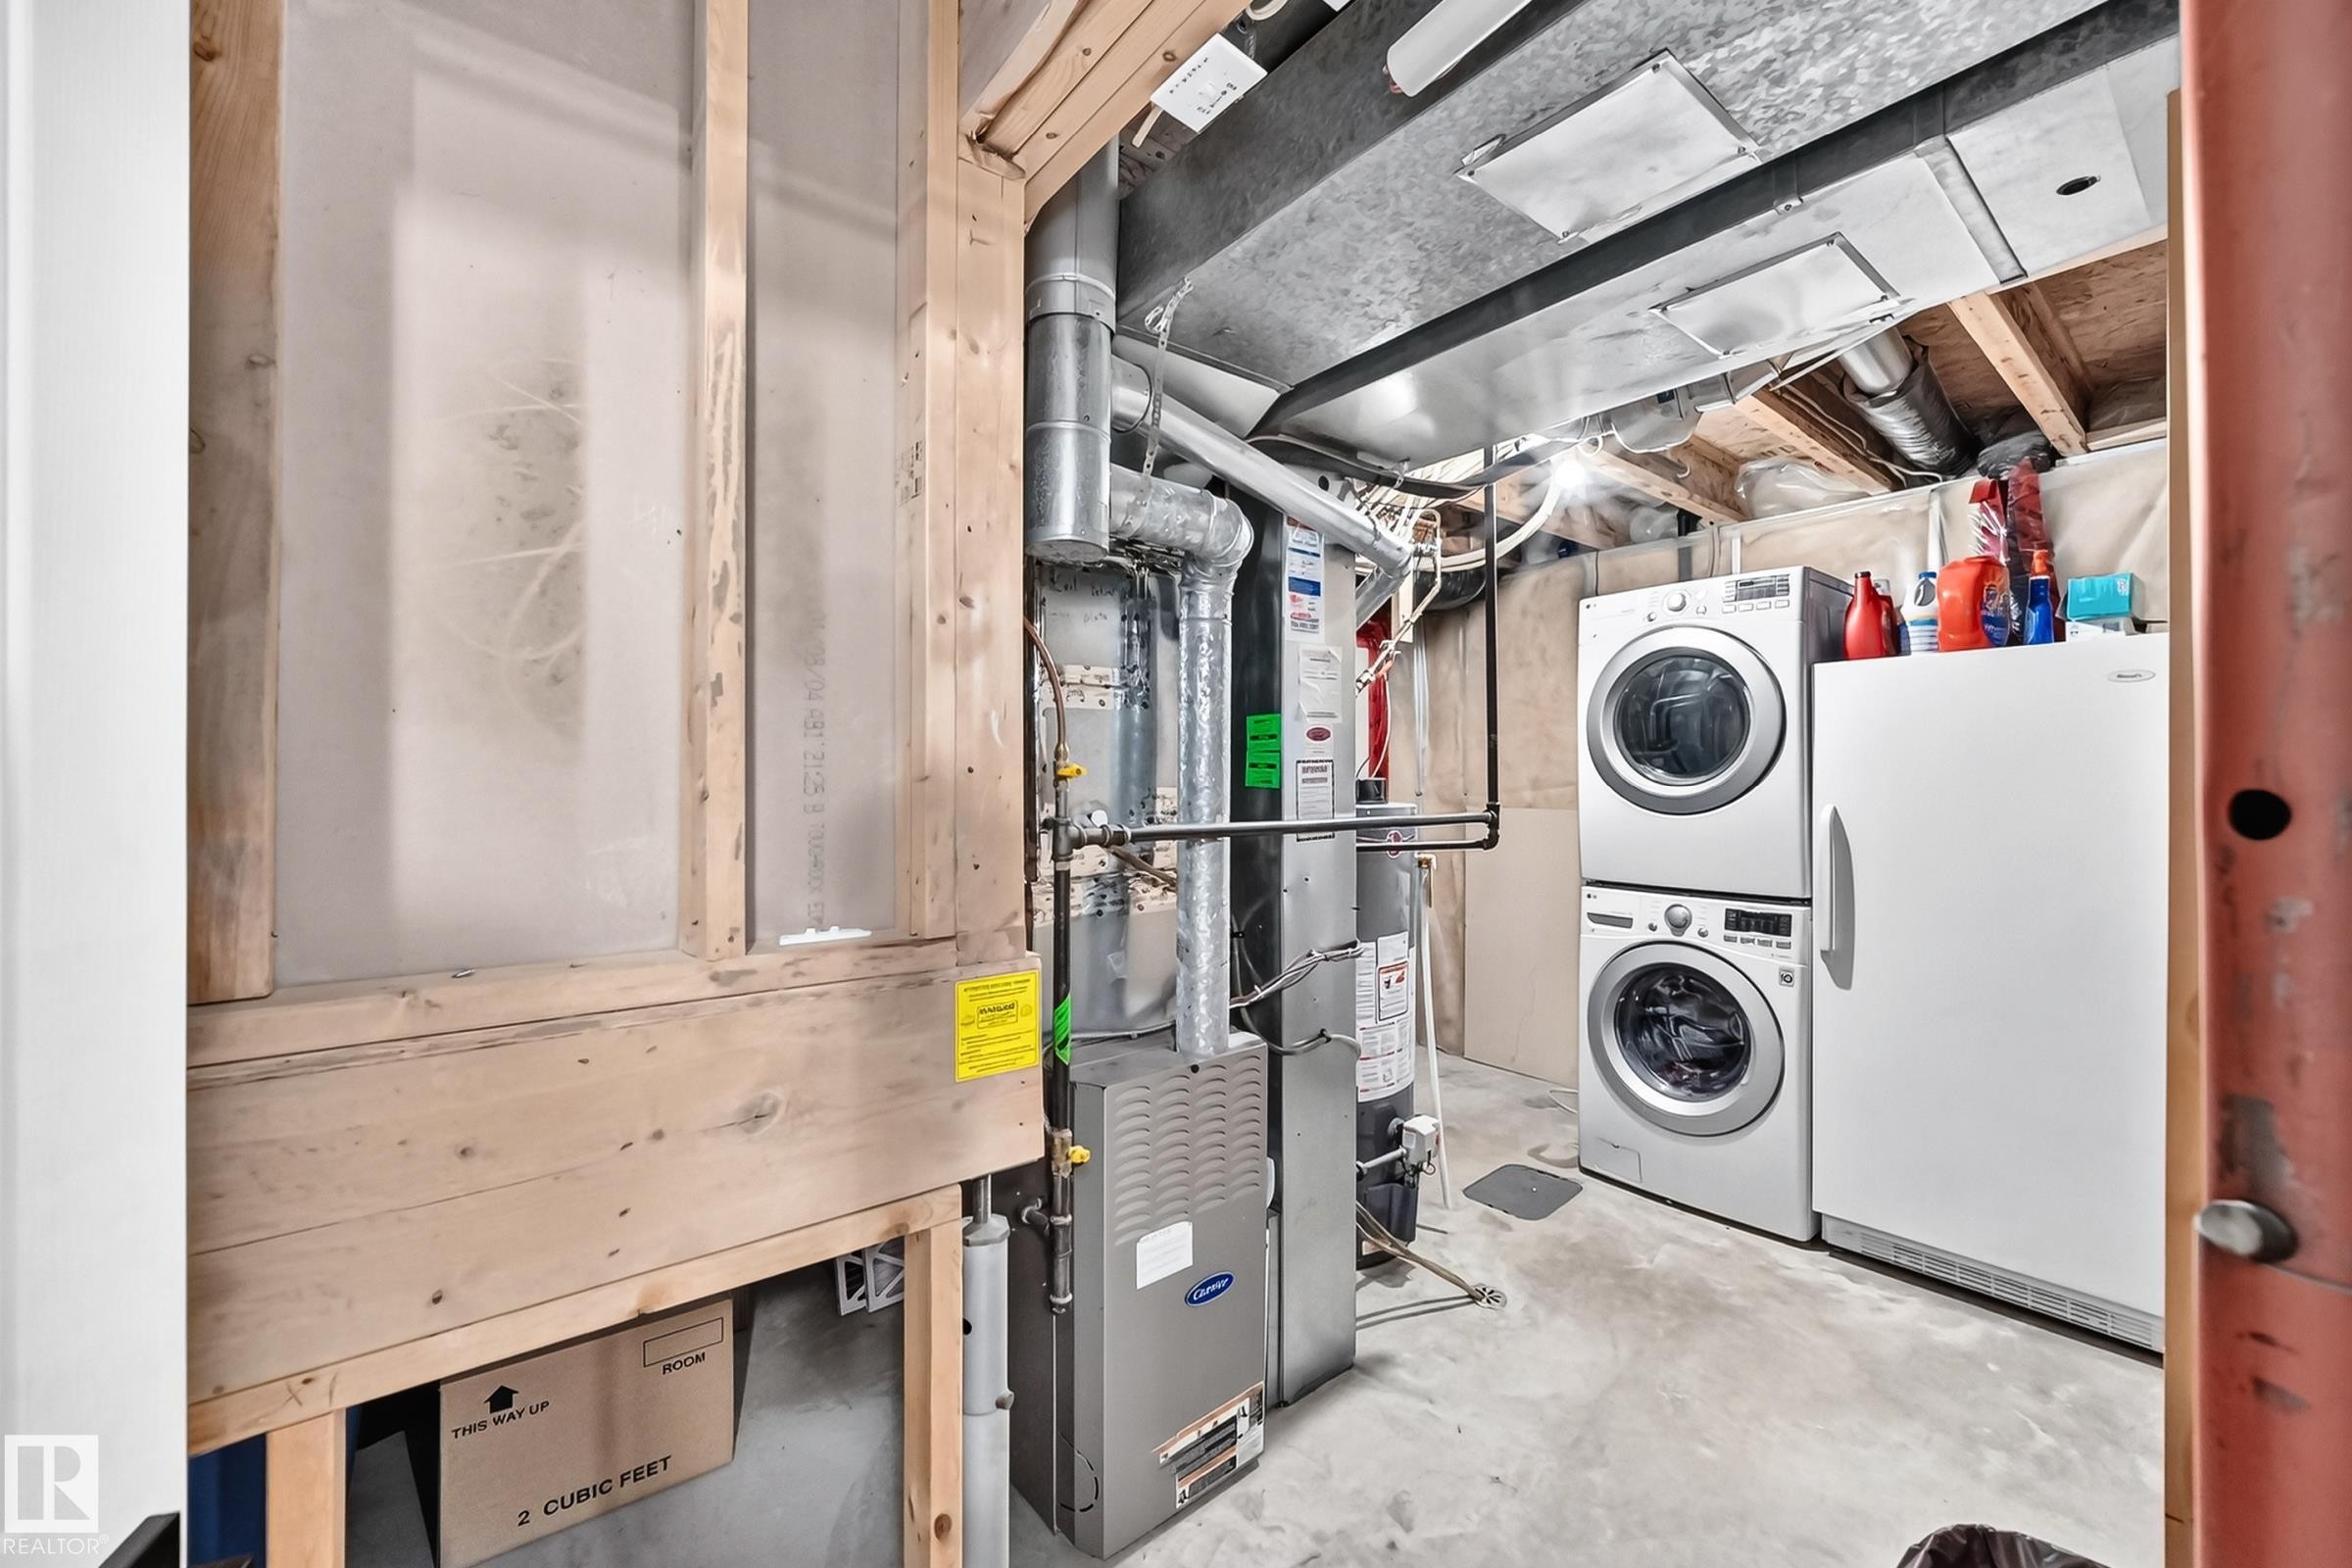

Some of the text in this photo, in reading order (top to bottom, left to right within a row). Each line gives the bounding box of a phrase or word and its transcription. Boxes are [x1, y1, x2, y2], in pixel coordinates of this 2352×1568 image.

[662, 1351, 707, 1376] ROOM
[451, 1400, 550, 1440] THIS WAY UP
[517, 1454, 672, 1527] 2 CUBIC FEET
